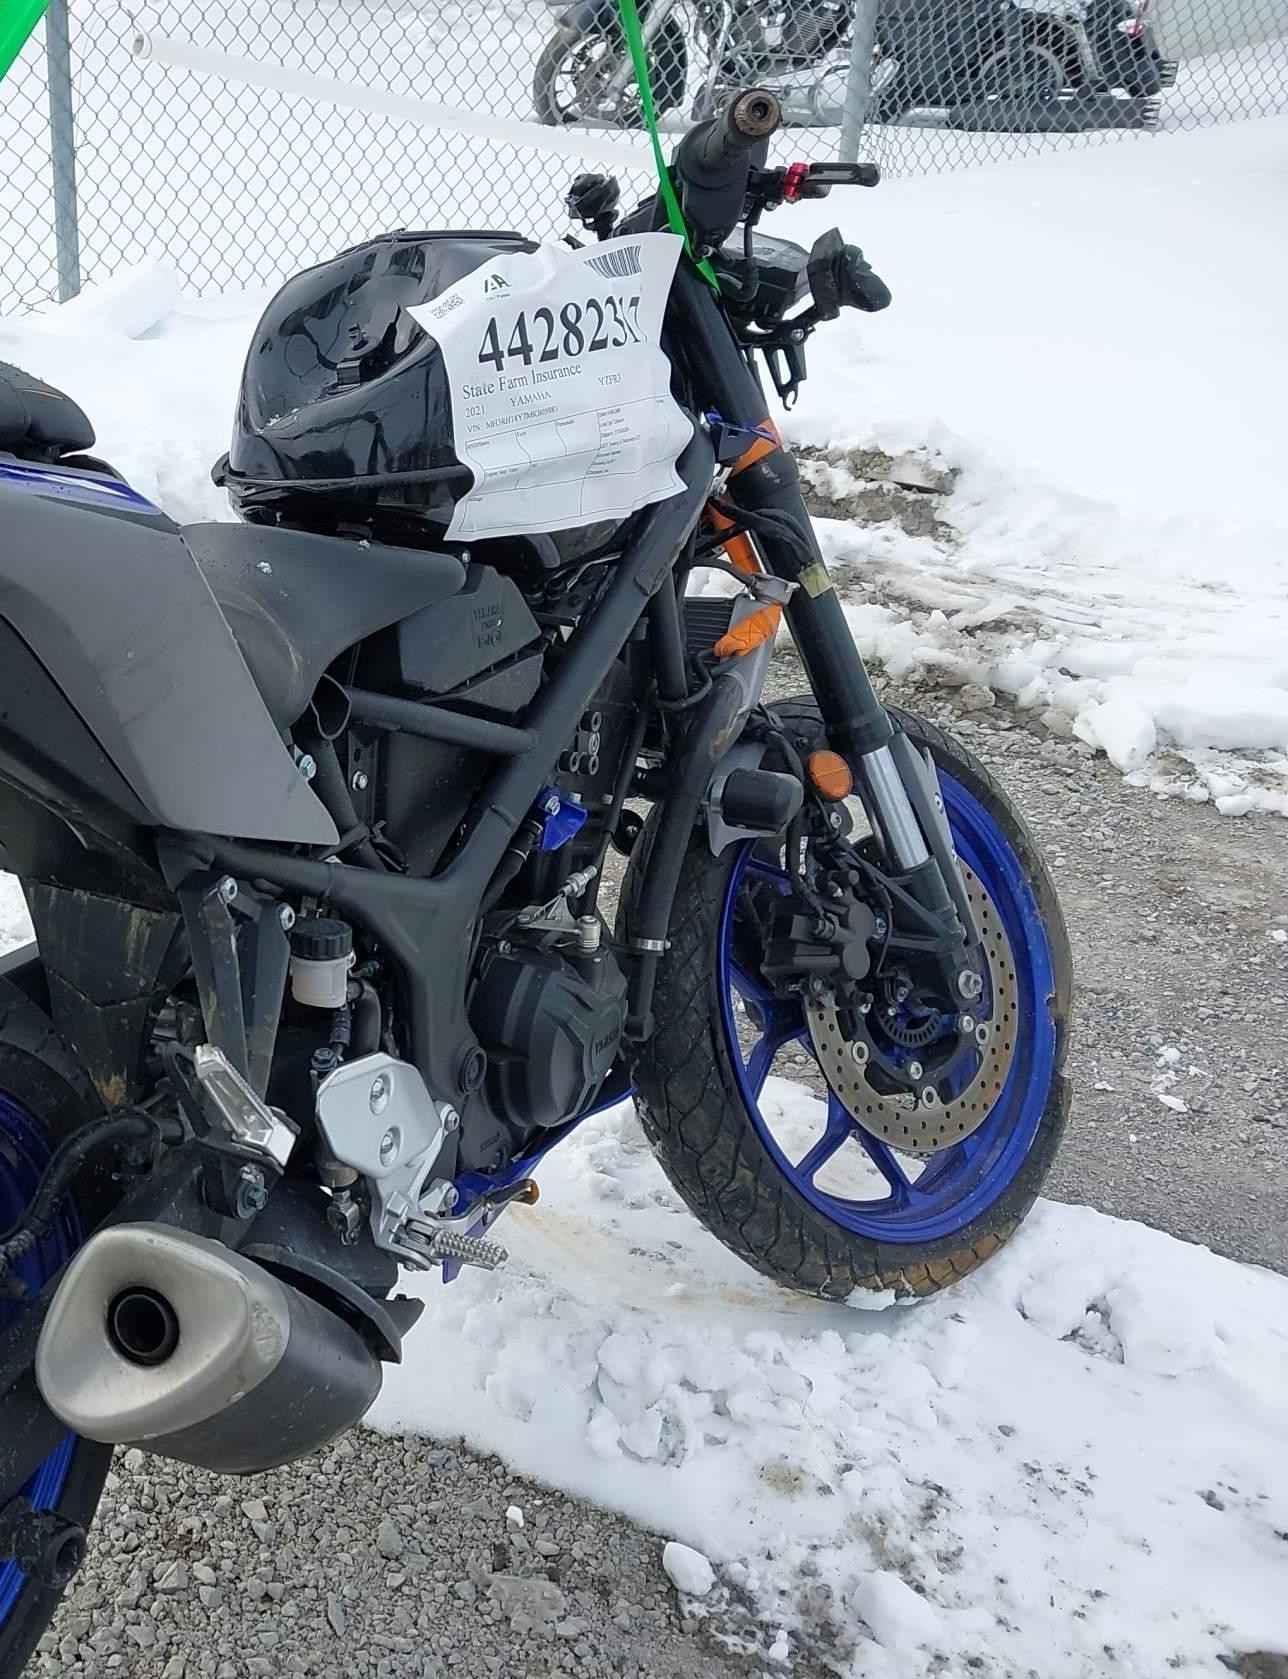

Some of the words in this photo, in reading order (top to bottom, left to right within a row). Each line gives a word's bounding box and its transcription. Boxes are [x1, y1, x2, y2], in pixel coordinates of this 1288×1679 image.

[462, 382, 495, 400] State
[498, 375, 529, 392] Farm
[531, 362, 582, 385] Insurance
[465, 403, 486, 418] 2021
[510, 389, 552, 408] YAMAHA
